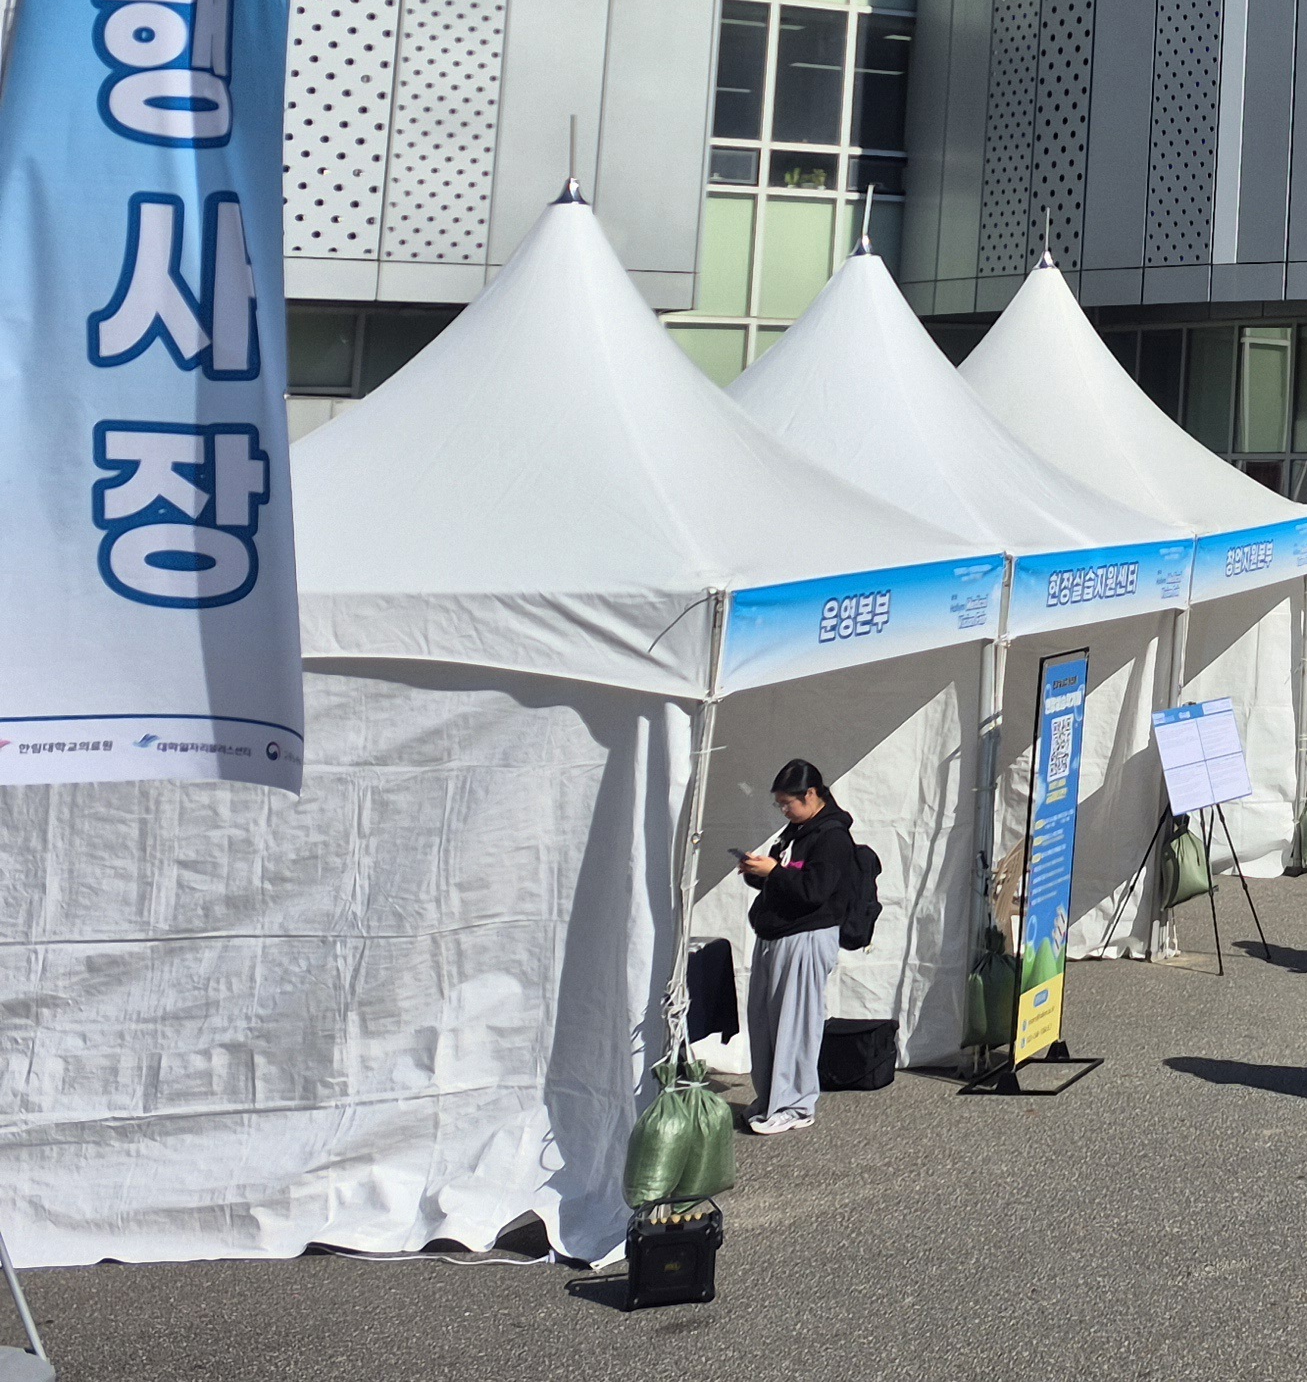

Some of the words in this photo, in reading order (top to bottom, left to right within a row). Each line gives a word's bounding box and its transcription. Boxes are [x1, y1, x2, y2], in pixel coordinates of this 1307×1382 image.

[1225, 539, 1274, 578] 창업지원본부
[1046, 561, 1139, 608] 현장실습지원센터
[818, 589, 891, 644] 운영본부
